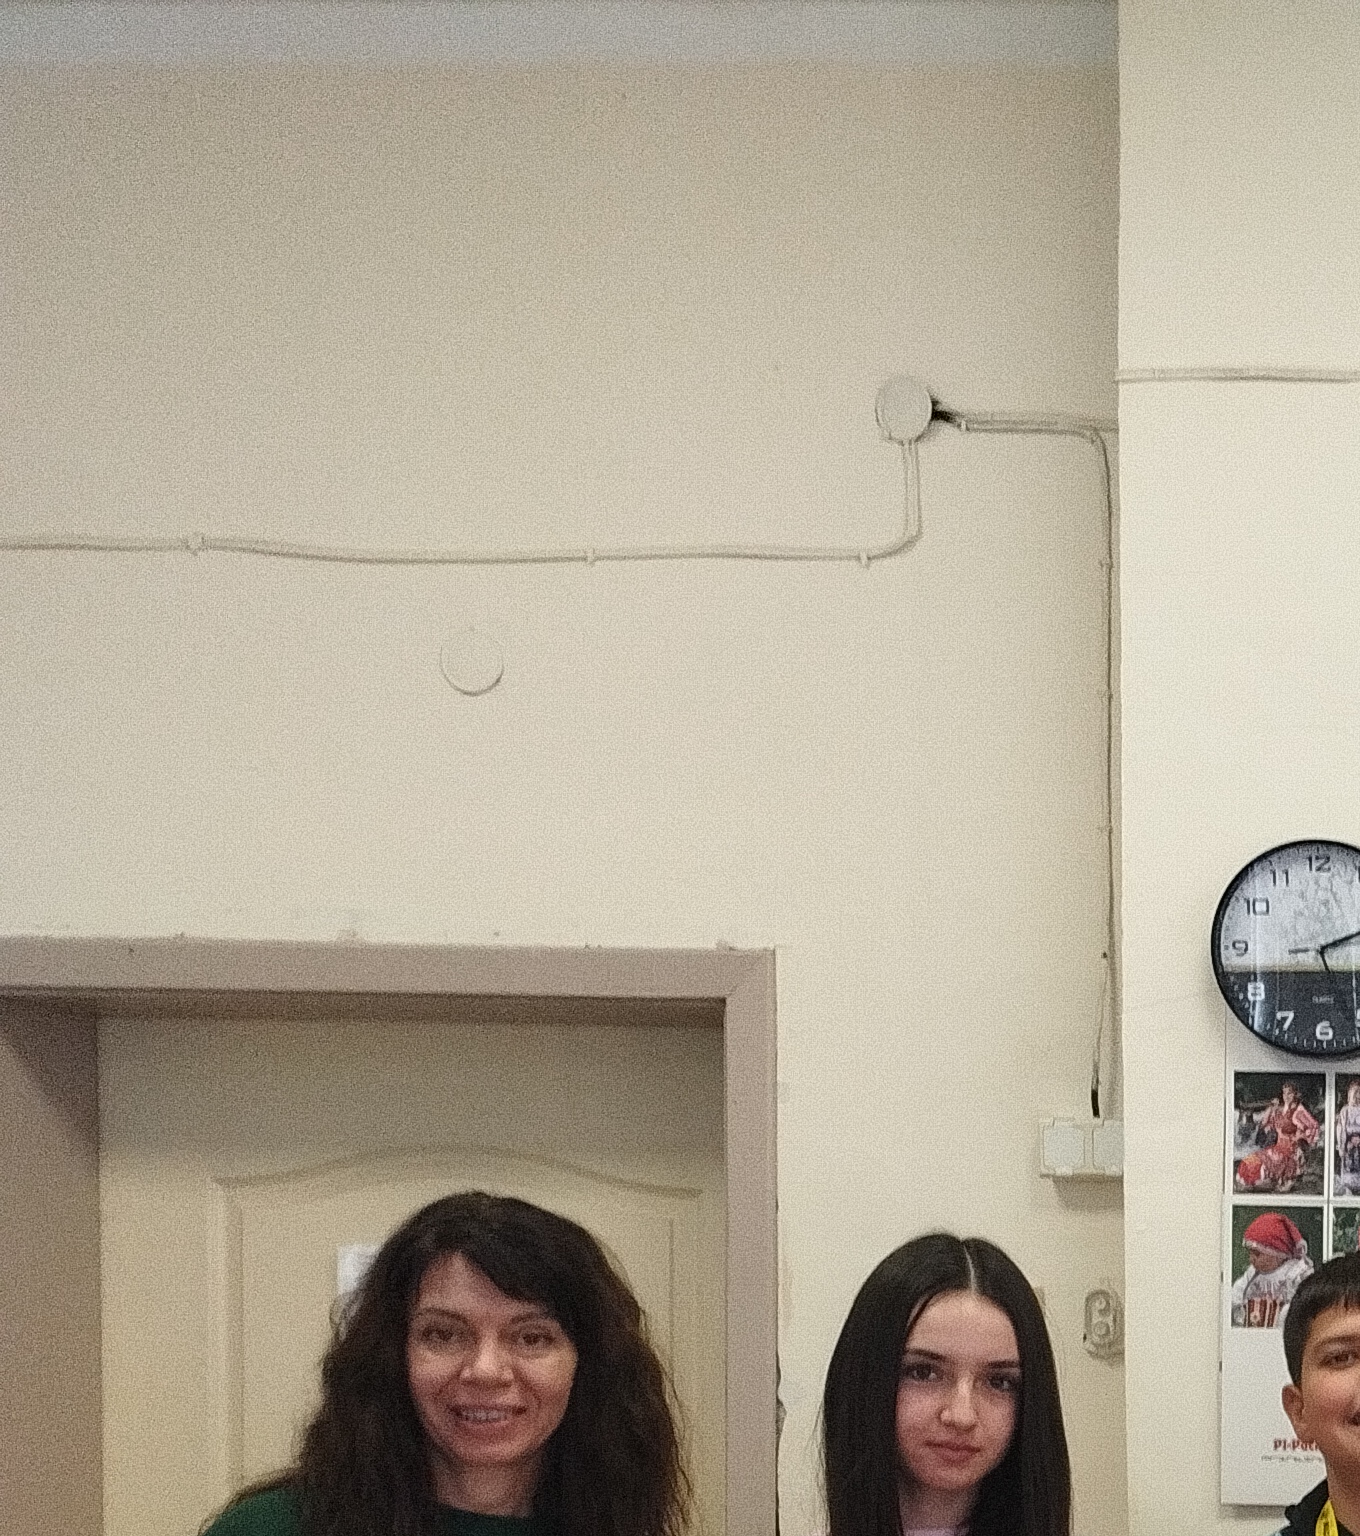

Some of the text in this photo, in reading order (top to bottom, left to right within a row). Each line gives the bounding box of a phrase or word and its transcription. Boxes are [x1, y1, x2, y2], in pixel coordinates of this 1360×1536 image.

[1307, 855, 1331, 873] 12
[1270, 868, 1289, 887] 11
[1245, 897, 1270, 916] 10
[1232, 939, 1249, 957] 9
[1247, 981, 1265, 1001] 8
[1276, 1010, 1295, 1031] 7
[1315, 1020, 1334, 1040] 6
